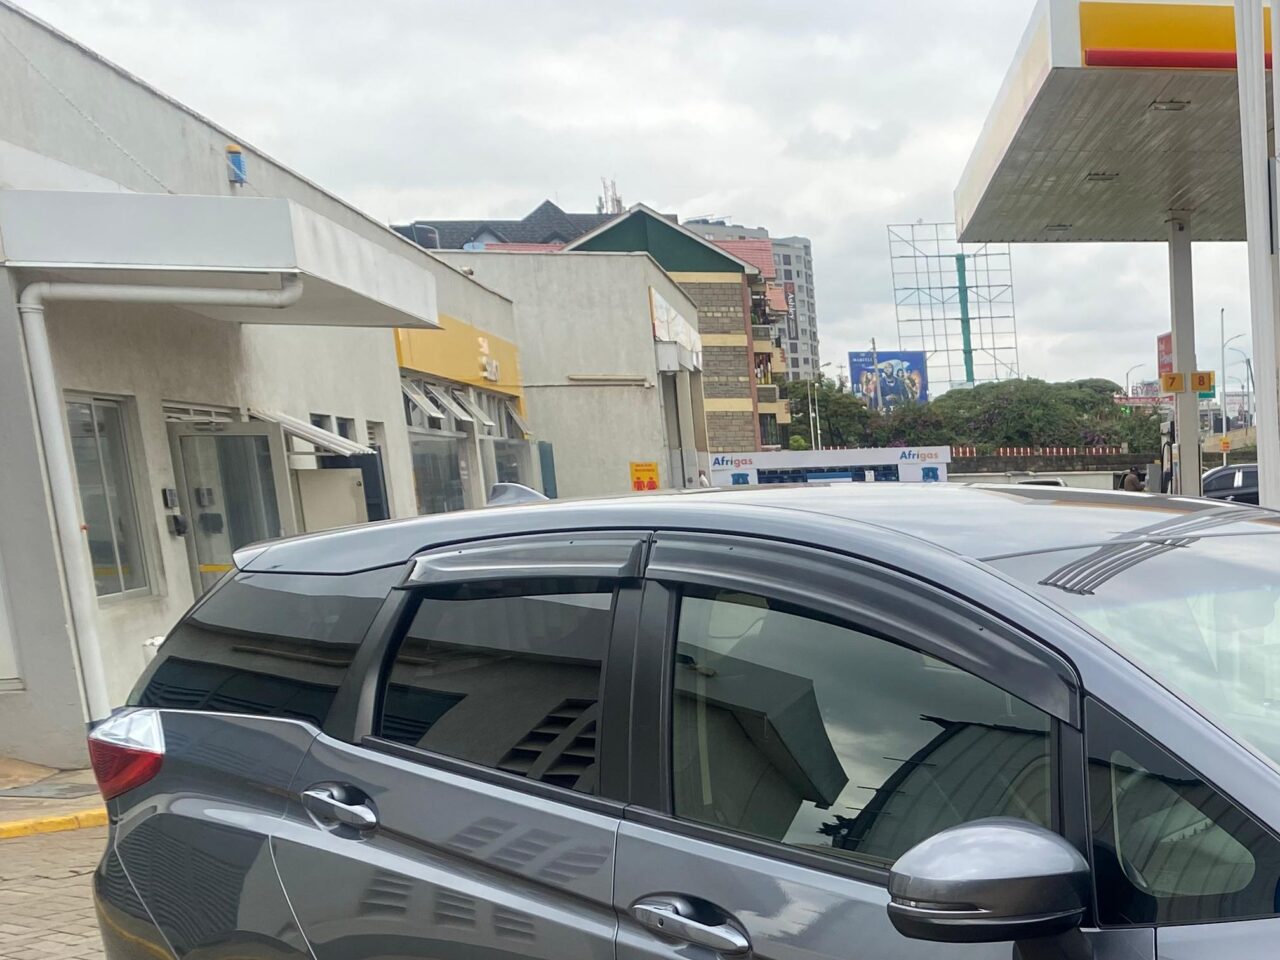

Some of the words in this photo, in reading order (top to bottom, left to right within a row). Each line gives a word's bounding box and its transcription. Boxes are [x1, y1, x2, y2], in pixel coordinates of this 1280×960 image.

[787, 292, 796, 320] Ashley
[1169, 377, 1176, 387] 7
[1198, 375, 1205, 386] 8
[900, 450, 938, 461] Afrigas
[712, 456, 753, 468] Afrigas
